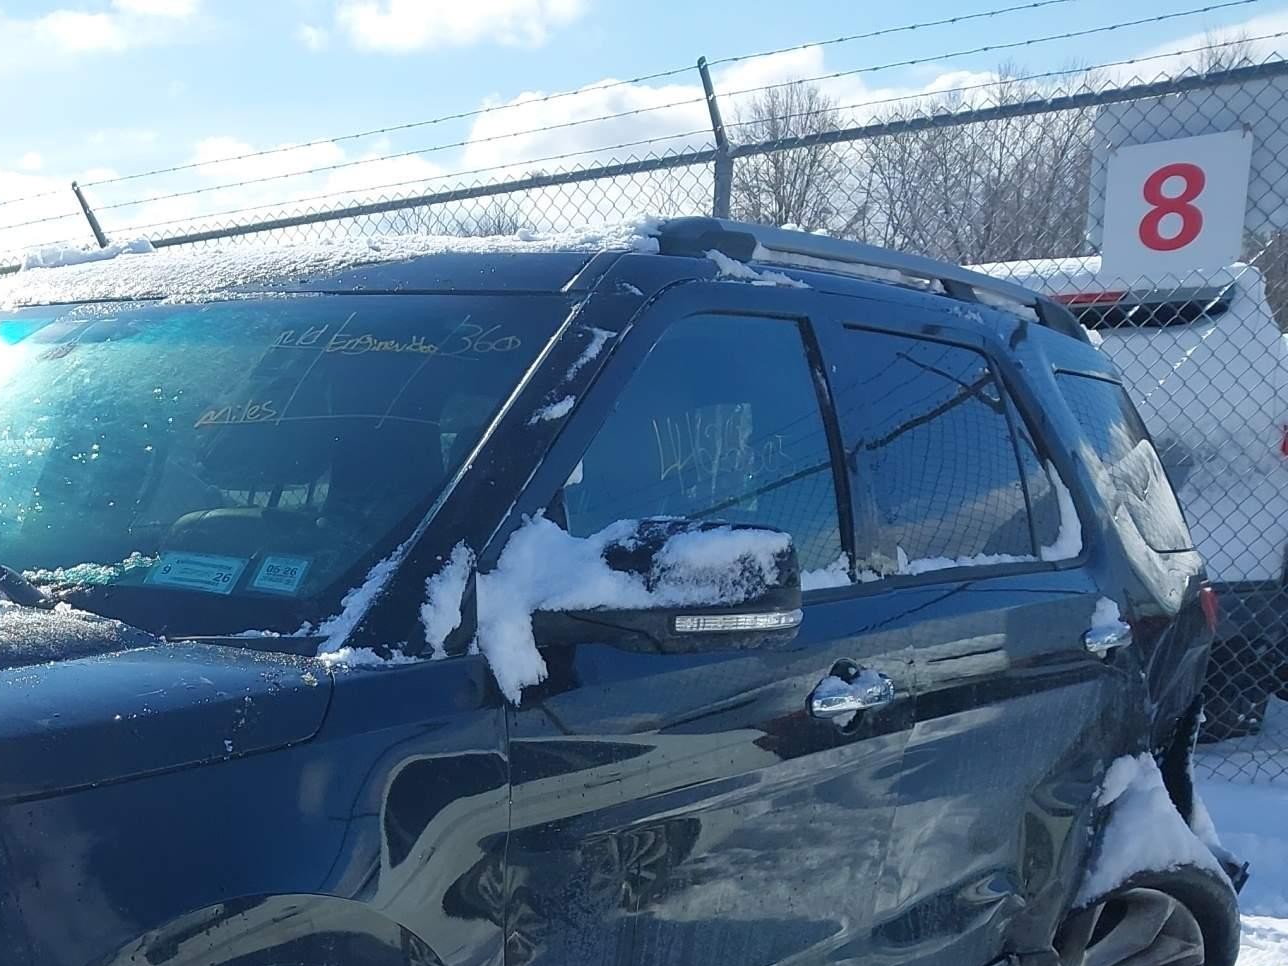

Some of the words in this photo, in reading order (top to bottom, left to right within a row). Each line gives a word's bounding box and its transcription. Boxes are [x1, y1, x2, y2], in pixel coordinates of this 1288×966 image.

[1138, 162, 1206, 252] 8
[161, 563, 173, 575] 9
[212, 572, 233, 583] 26
